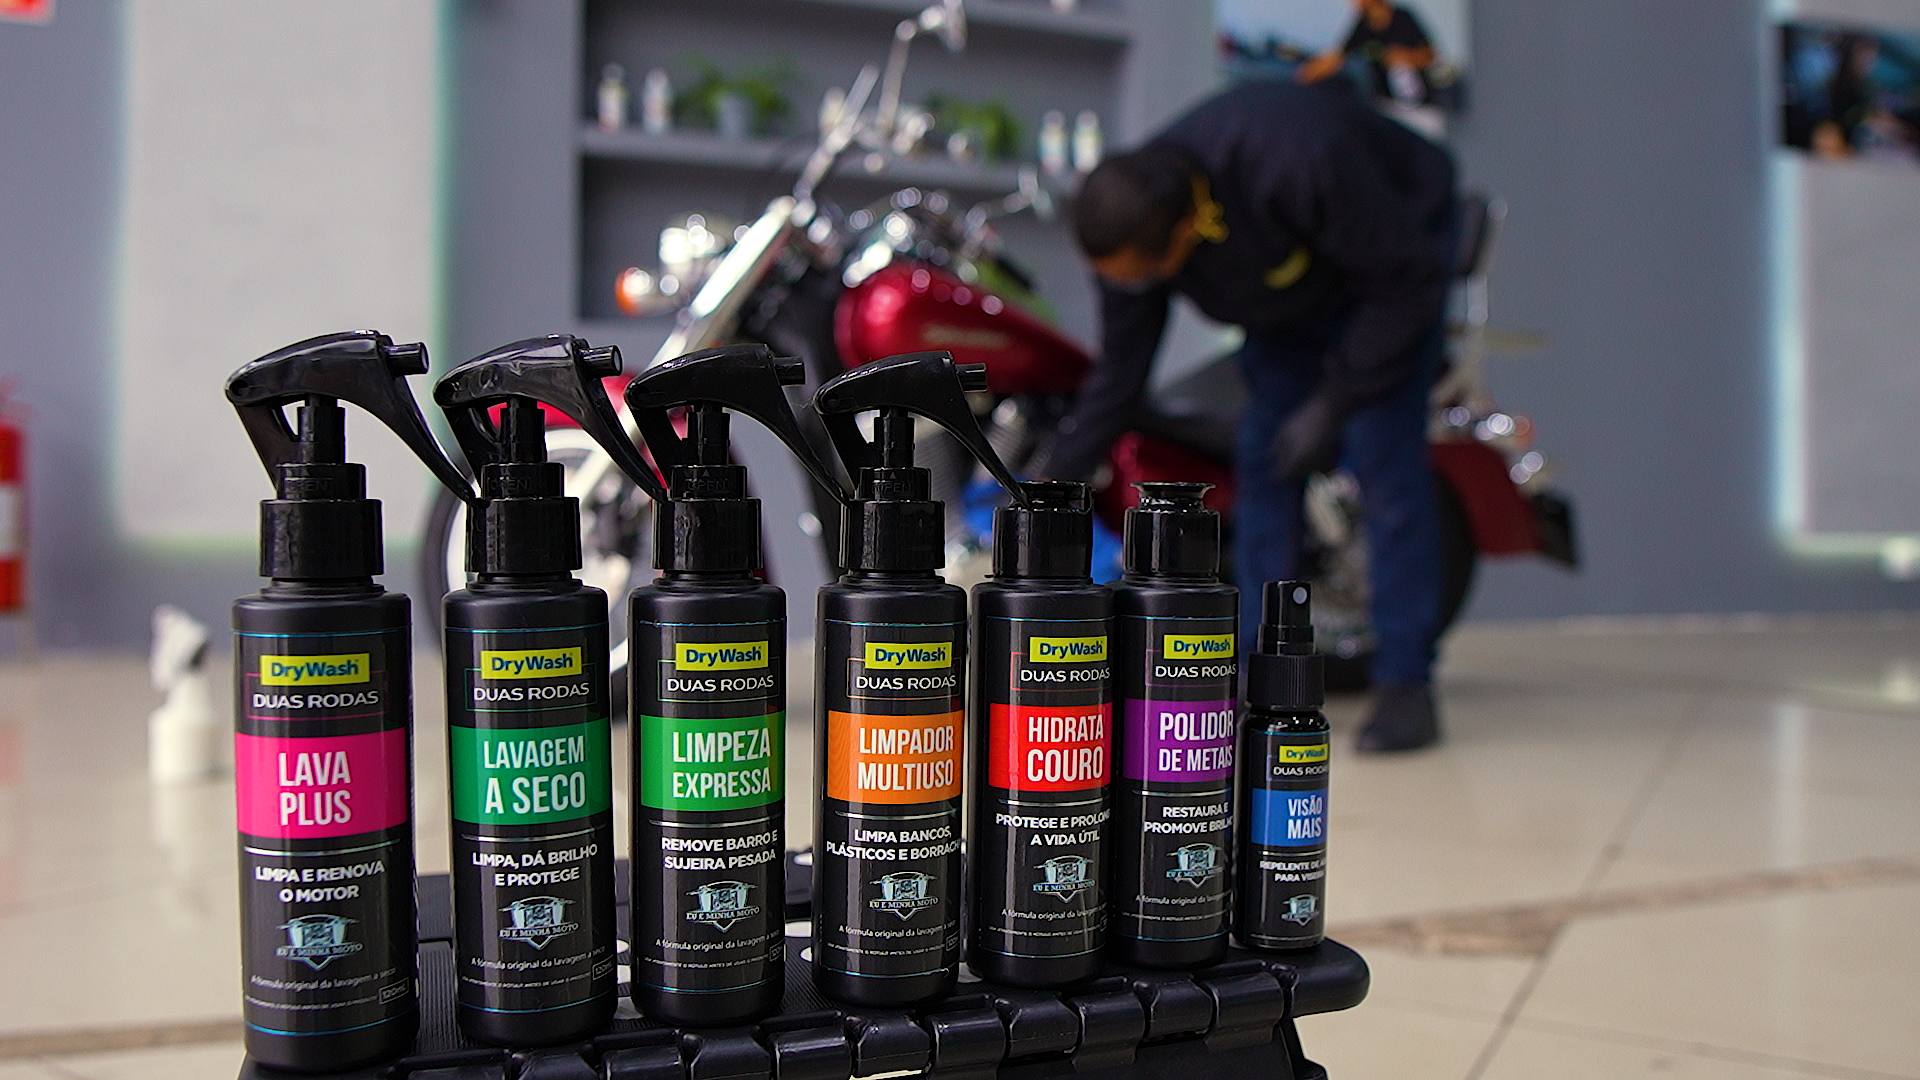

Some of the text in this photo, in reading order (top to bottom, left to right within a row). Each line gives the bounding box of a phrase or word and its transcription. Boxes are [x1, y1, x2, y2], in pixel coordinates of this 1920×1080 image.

[686, 646, 762, 667] DryWash
[875, 648, 946, 666] DryWash
[1040, 641, 1103, 658] DryWash
[1174, 640, 1231, 656] DryWash
[271, 660, 359, 681] DryWash
[491, 653, 573, 674] DryWash
[1155, 664, 1236, 678] DUAS RODAS
[667, 675, 774, 692] DUAS RODAS
[856, 675, 956, 690] DUAS RODAS
[1021, 667, 1110, 682] DUAS RODAS
[253, 691, 379, 708] DUAS RODAS
[474, 683, 589, 701] DUAS RODAS
[1028, 714, 1104, 743] HIDRATA
[1160, 709, 1234, 741] POLIDOR
[673, 727, 772, 763] LIMPEZA
[860, 725, 954, 755] LIMPADOR
[484, 736, 584, 769] LAVAGEM
[1158, 745, 1232, 772] DE METAIS
[278, 751, 352, 787] LAVA
[1027, 746, 1103, 782] COURO
[1273, 766, 1304, 776] DUAS
[673, 767, 771, 798] EXPRESSA
[858, 759, 954, 791] MULTIUSO
[485, 771, 586, 814] A SECO
[279, 790, 352, 826] PLUS
[1163, 801, 1229, 818] RESTAURA E
[1288, 794, 1323, 817] VISÃO
[996, 813, 1058, 829] PROTEGE
[1060, 818, 1069, 828] E
[1143, 822, 1208, 834] PROMOVE
[1287, 818, 1322, 840] MAIS
[661, 829, 778, 852] REMOVE BARRO E
[854, 825, 952, 843] LIMPA BANCOS,
[1030, 830, 1100, 846] A VIDA ÚTIL
[472, 844, 598, 869] LIMPA, DÁ BRILHO
[664, 849, 776, 870] SUJEIRA PESADA
[826, 841, 896, 860] PLÁSTICOS
[898, 849, 908, 860] E
[255, 860, 386, 883] LIMPA E RENOVA
[495, 867, 580, 886] E PROTEGE
[1275, 873, 1301, 882] PARA
[279, 885, 360, 902] O MOTOR
[917, 897, 938, 907] MOTO
[737, 906, 760, 917] MOTO
[1038, 911, 1066, 922] original
[875, 929, 904, 940] original
[906, 929, 915, 937] da
[692, 940, 724, 953] original
[725, 940, 735, 949] da
[737, 935, 765, 947] lavagem
[507, 960, 540, 972] original
